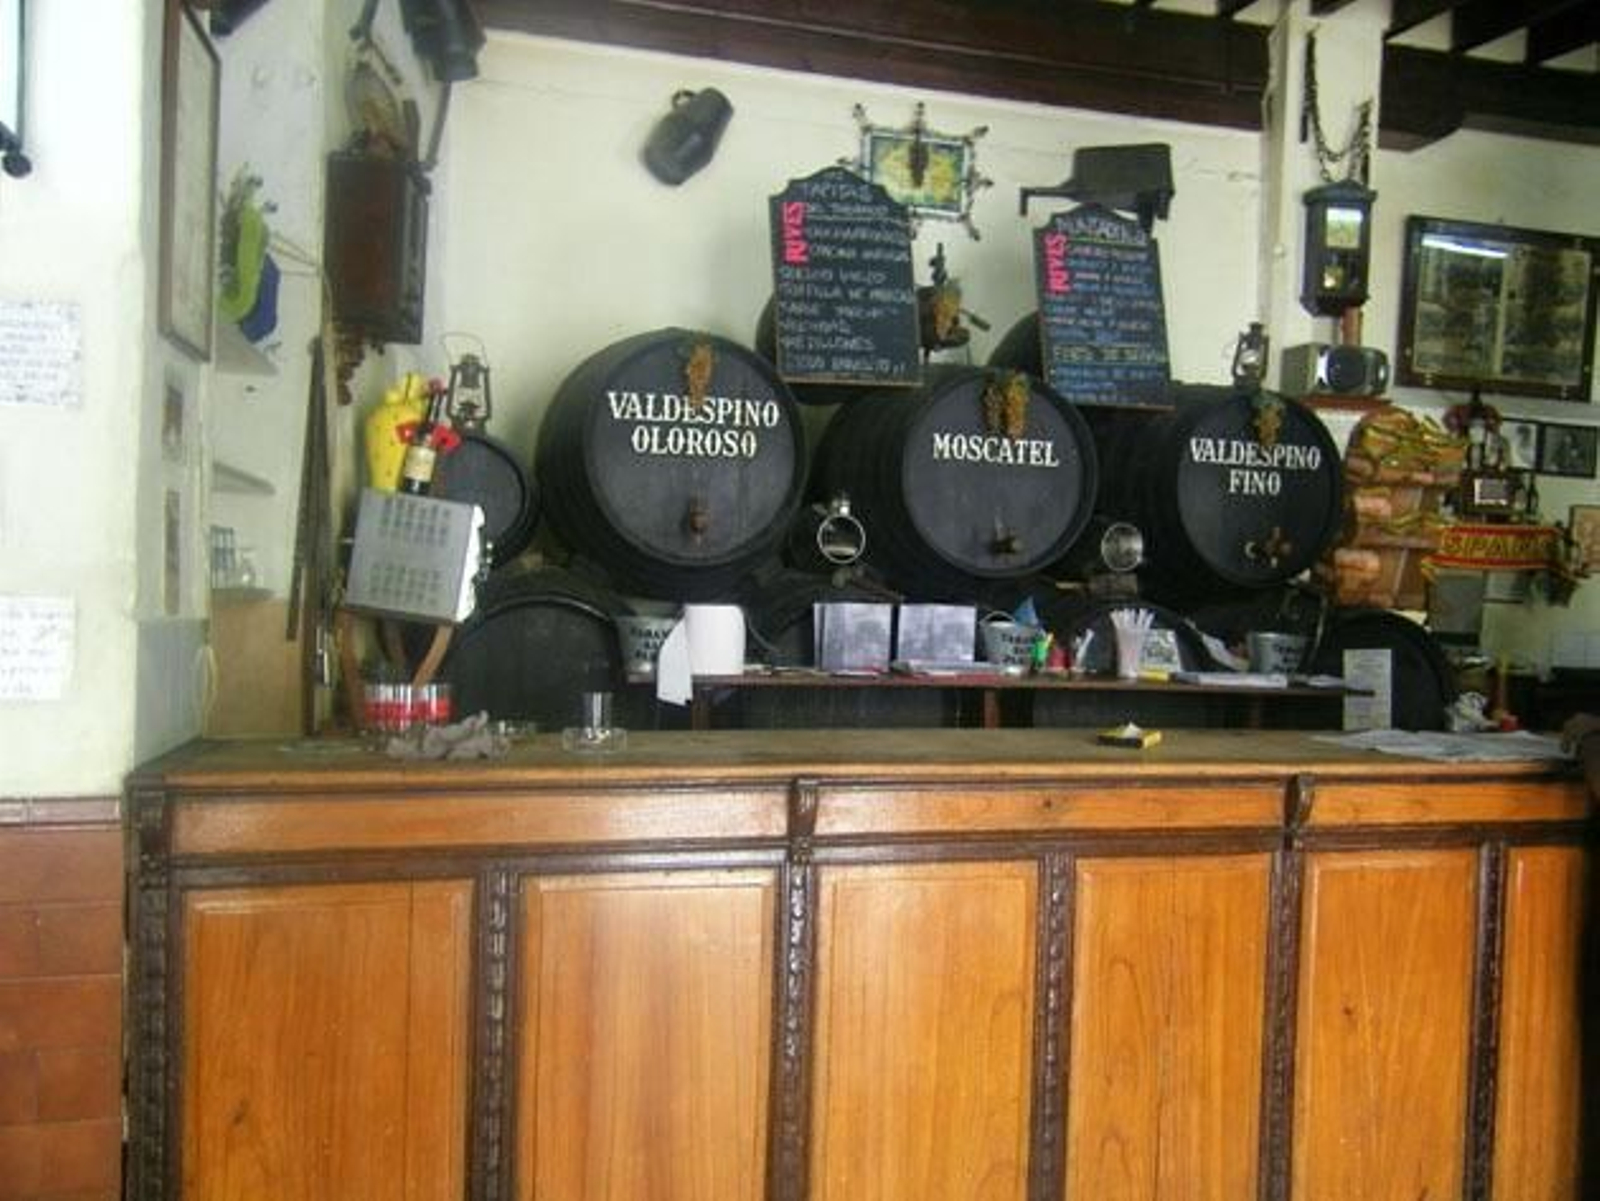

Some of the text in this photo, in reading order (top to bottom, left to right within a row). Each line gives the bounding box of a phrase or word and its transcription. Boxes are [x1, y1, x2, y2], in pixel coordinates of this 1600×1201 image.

[607, 391, 780, 427] VALDESPINO
[631, 425, 758, 458] OLOROSO
[932, 432, 1060, 467] MOSCATEL
[1189, 437, 1321, 470] VALDESPINO
[1229, 468, 1282, 496] FINO
